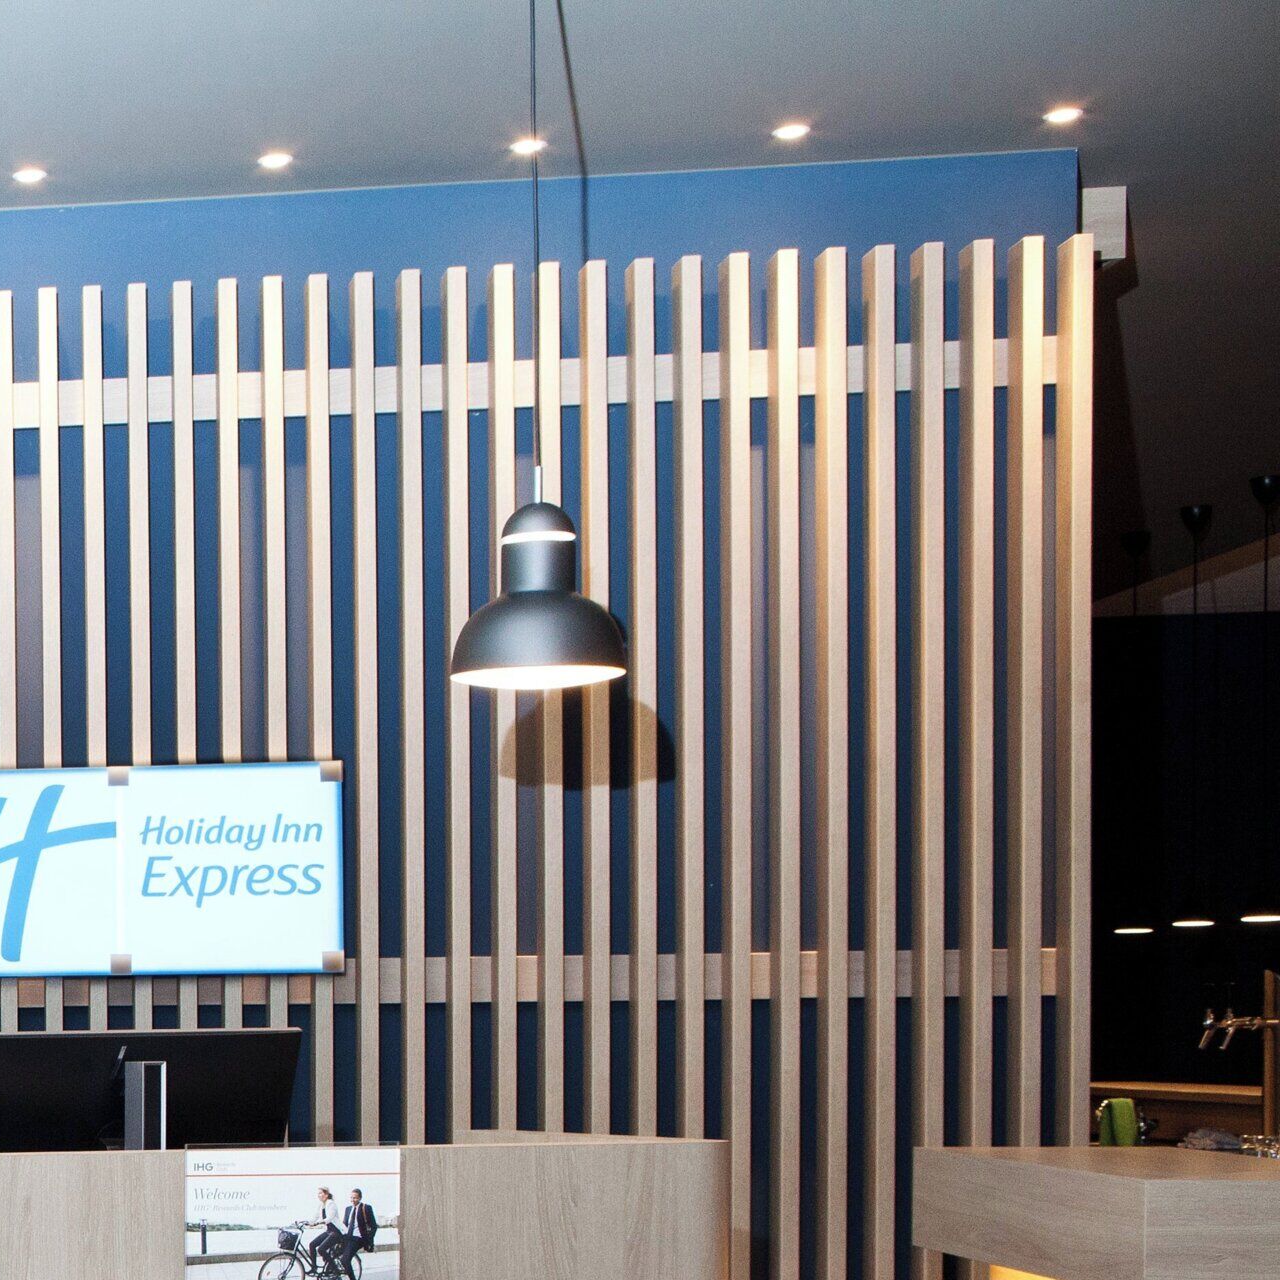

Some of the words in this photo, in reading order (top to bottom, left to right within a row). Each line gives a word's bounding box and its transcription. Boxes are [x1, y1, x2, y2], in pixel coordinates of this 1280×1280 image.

[139, 813, 265, 851] Holiday
[272, 813, 323, 844] Inn
[140, 855, 325, 909] Express
[193, 1162, 214, 1172] IHG
[194, 1187, 251, 1200] Welcome
